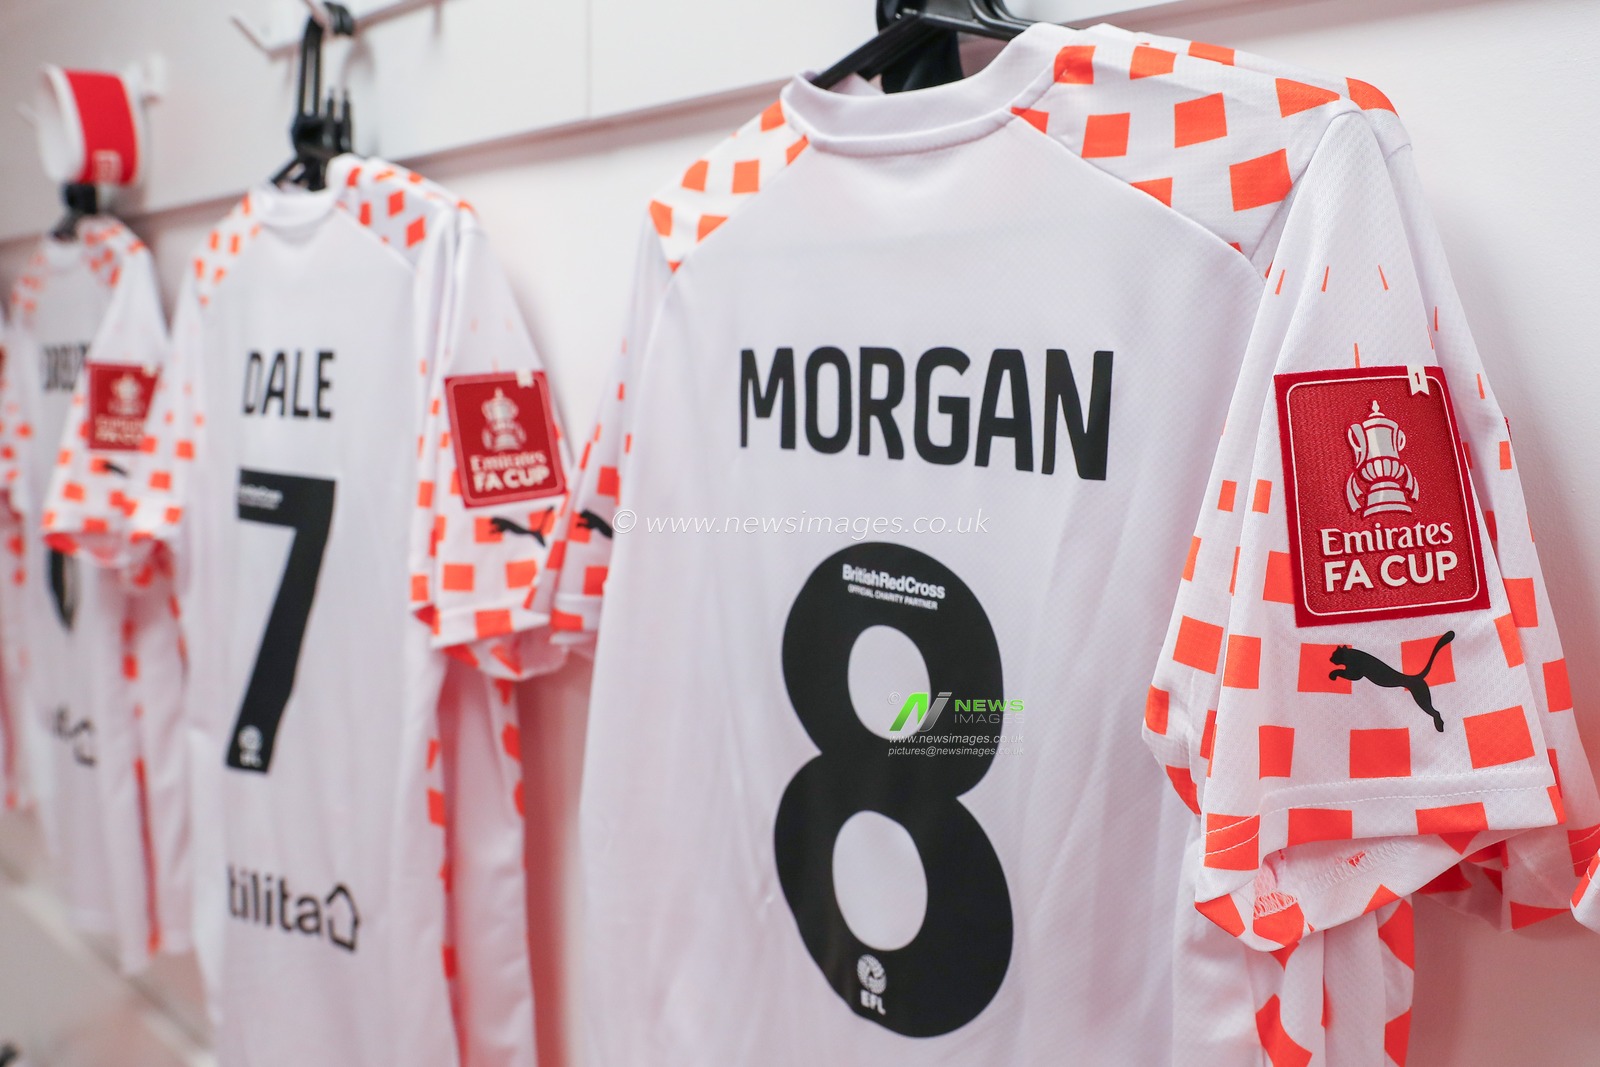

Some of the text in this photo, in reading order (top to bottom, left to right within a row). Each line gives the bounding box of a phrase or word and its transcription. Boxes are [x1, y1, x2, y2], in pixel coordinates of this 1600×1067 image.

[244, 351, 336, 420] DALE
[1413, 373, 1421, 385] 1
[739, 346, 1114, 481] MORGAN
[470, 451, 547, 472] Emirates
[473, 465, 550, 492] FA CUP
[1320, 522, 1453, 556] Emirates
[1324, 550, 1458, 592] FA CUP
[227, 469, 336, 774] 7
[773, 541, 1014, 1039] 8
[860, 988, 886, 1016] EFL
